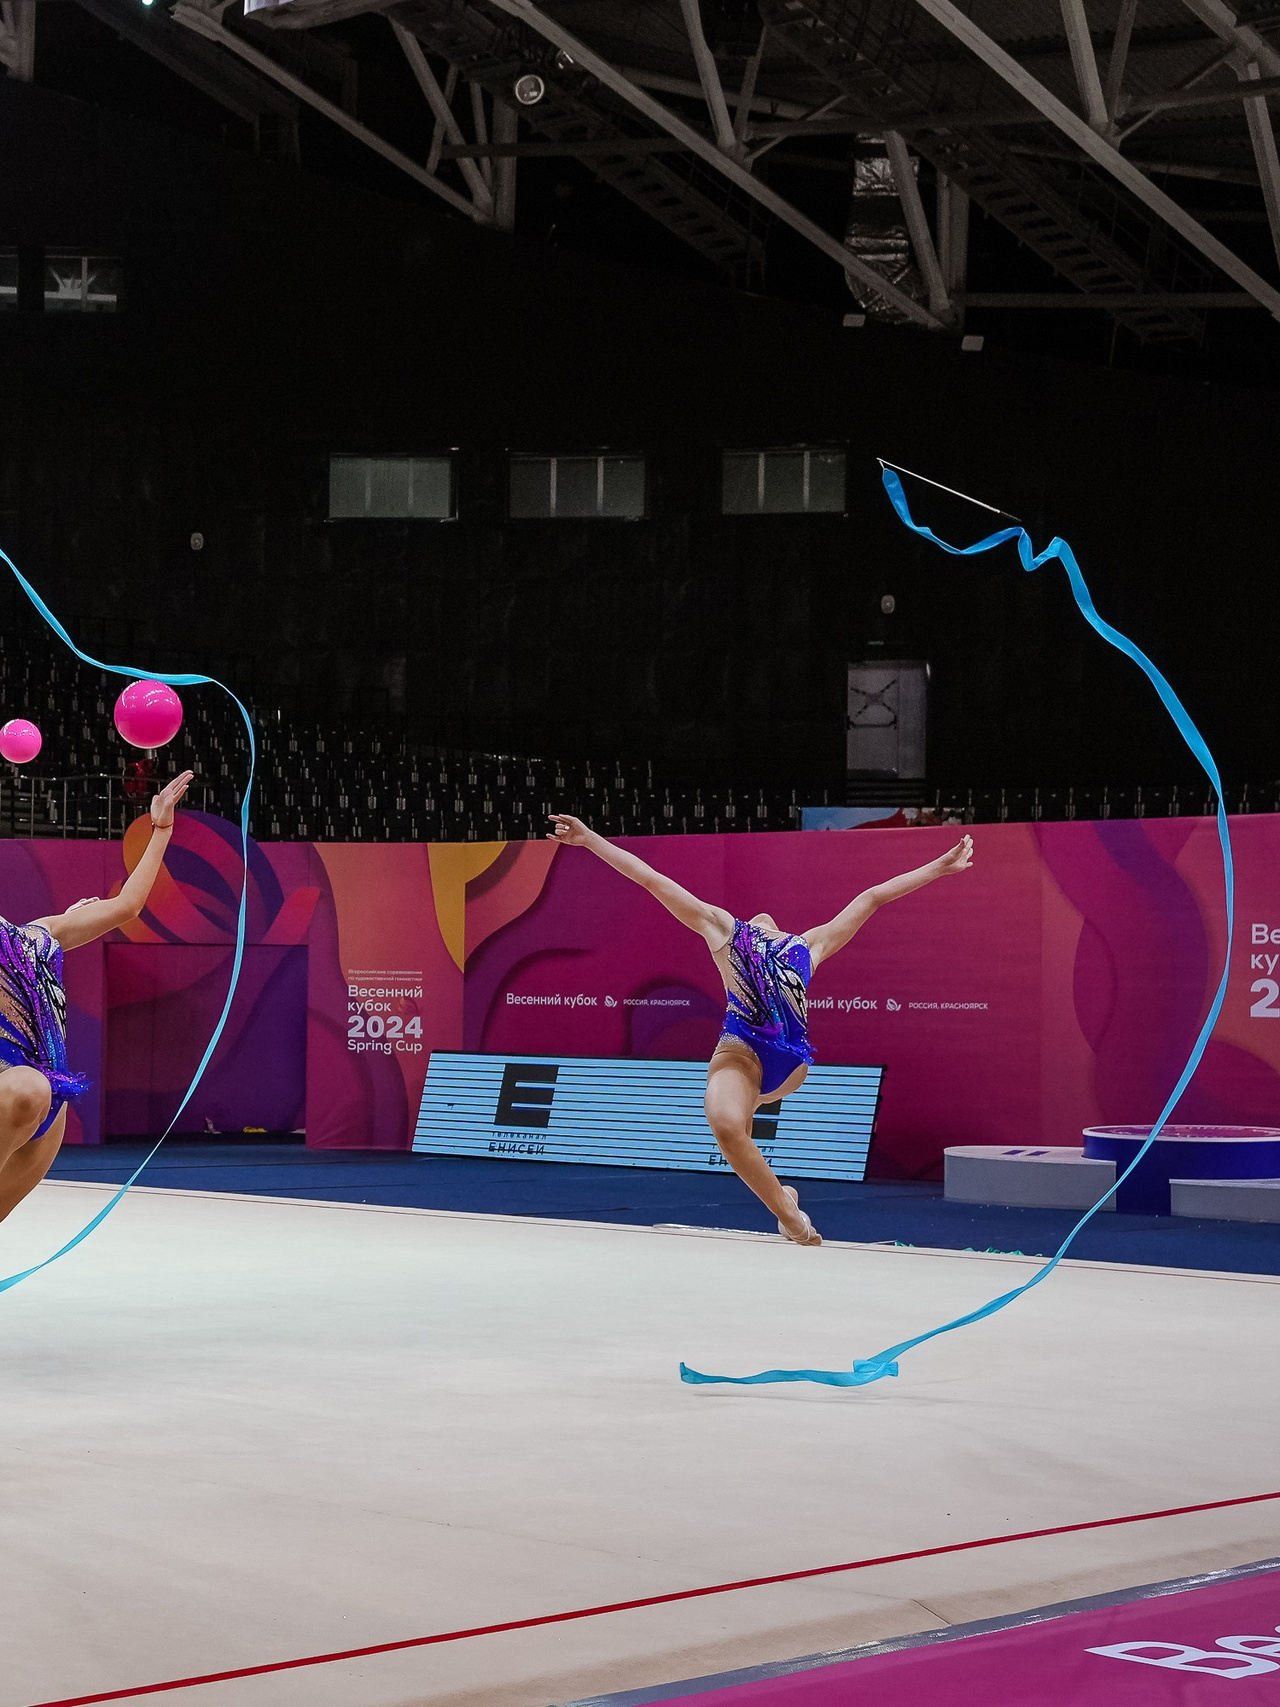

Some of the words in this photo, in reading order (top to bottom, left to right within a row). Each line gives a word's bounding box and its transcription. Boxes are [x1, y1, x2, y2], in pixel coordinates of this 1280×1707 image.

[348, 984, 423, 998] Весенний
[348, 999, 392, 1014] кубок
[506, 992, 561, 1006] Весенний
[564, 994, 598, 1009] кубок
[650, 999, 690, 1007] КРАСНОЯРСК
[838, 997, 878, 1012] кубок
[347, 1015, 423, 1039] 2024
[347, 1039, 392, 1055] Spring
[395, 1040, 423, 1054] Cup
